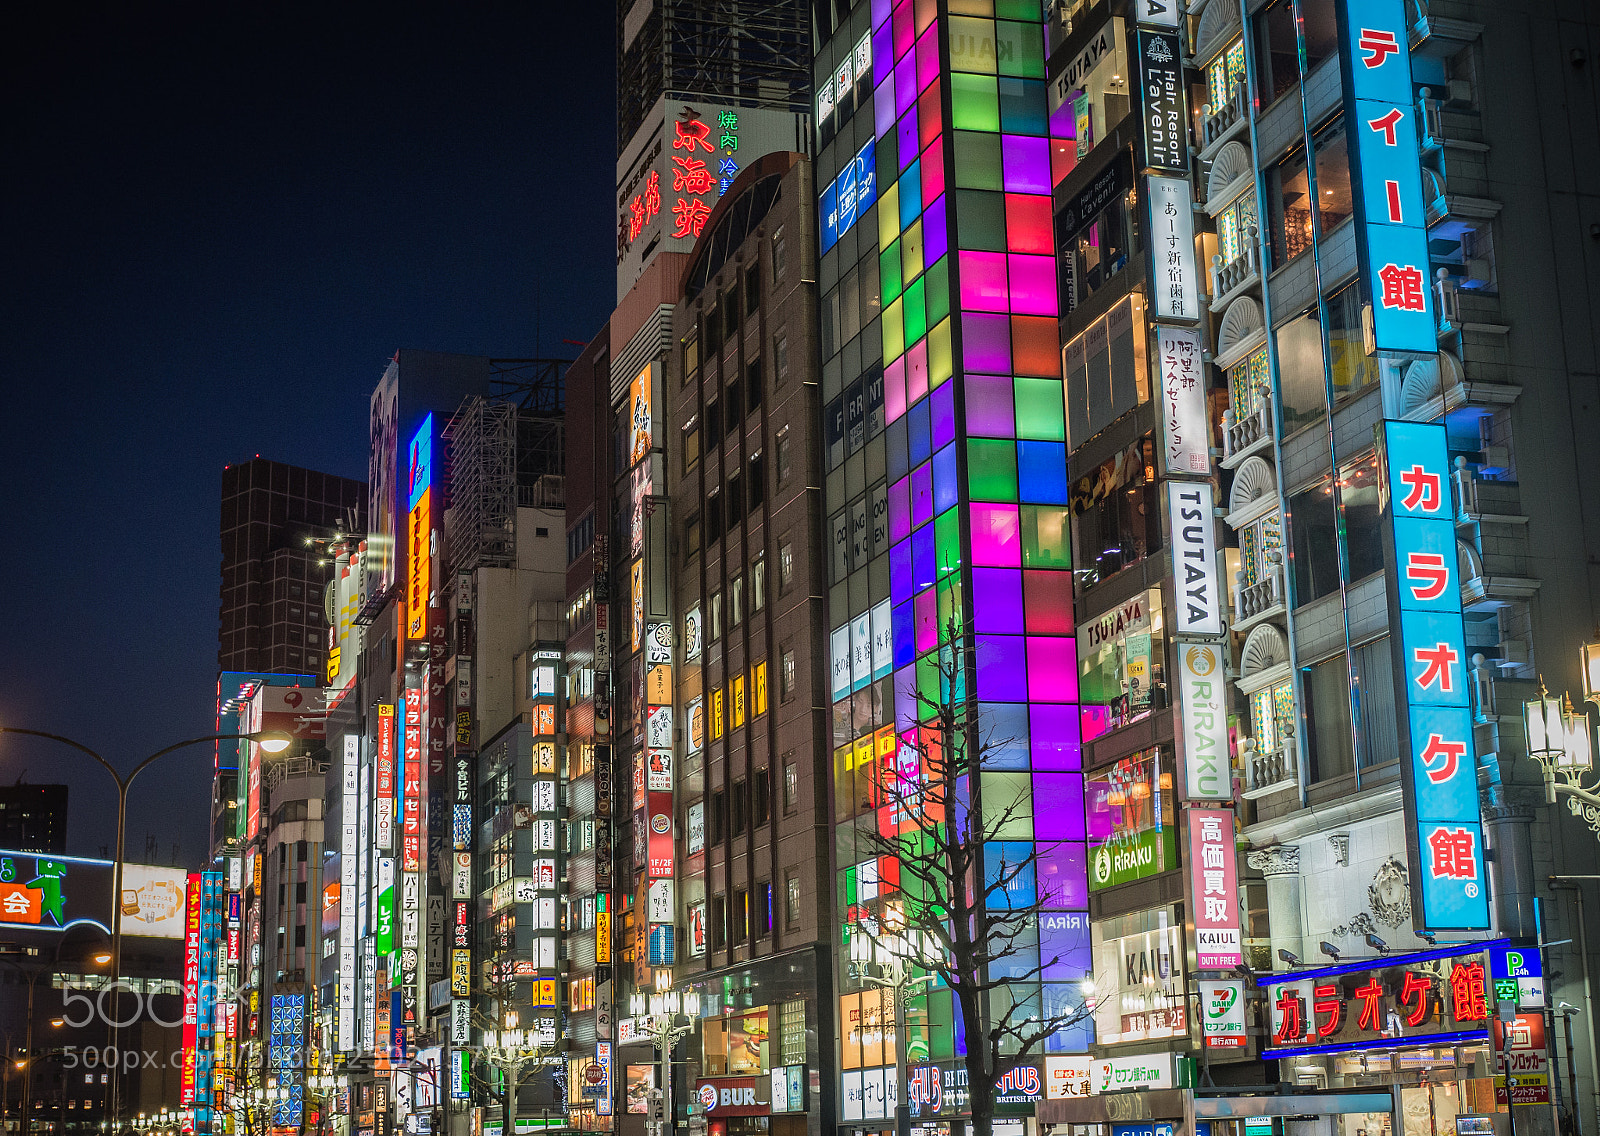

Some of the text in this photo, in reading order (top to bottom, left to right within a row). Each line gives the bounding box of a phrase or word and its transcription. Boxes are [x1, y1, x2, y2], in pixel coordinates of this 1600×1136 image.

[1057, 34, 1107, 99] TSUTAYA
[1148, 69, 1165, 164] L'avenir
[1164, 70, 1180, 166] Hair Resort
[1164, 202, 1185, 316] あーす新宿歯科
[1165, 340, 1182, 459] リラクゼーション
[1180, 490, 1209, 624] TSUTAYA
[1087, 603, 1142, 648] TSUTAYA
[1401, 465, 1477, 880] カラオケ館
[407, 692, 419, 759] カラオケ
[405, 780, 419, 831] パセラ
[1199, 816, 1228, 922] 高価買取
[3, 891, 31, 914] 会
[380, 906, 391, 935] レイク
[1199, 933, 1236, 944] KAIUL
[1201, 956, 1236, 966] DUTY FREE
[1507, 952, 1524, 976] P
[1170, 1010, 1184, 1027] 2F
[1205, 1021, 1242, 1031] セブン銀行
[1276, 961, 1488, 1040] カラオケ館
[1497, 1054, 1546, 1070] コンロッカー
[997, 1095, 1026, 1103] BRITISH
